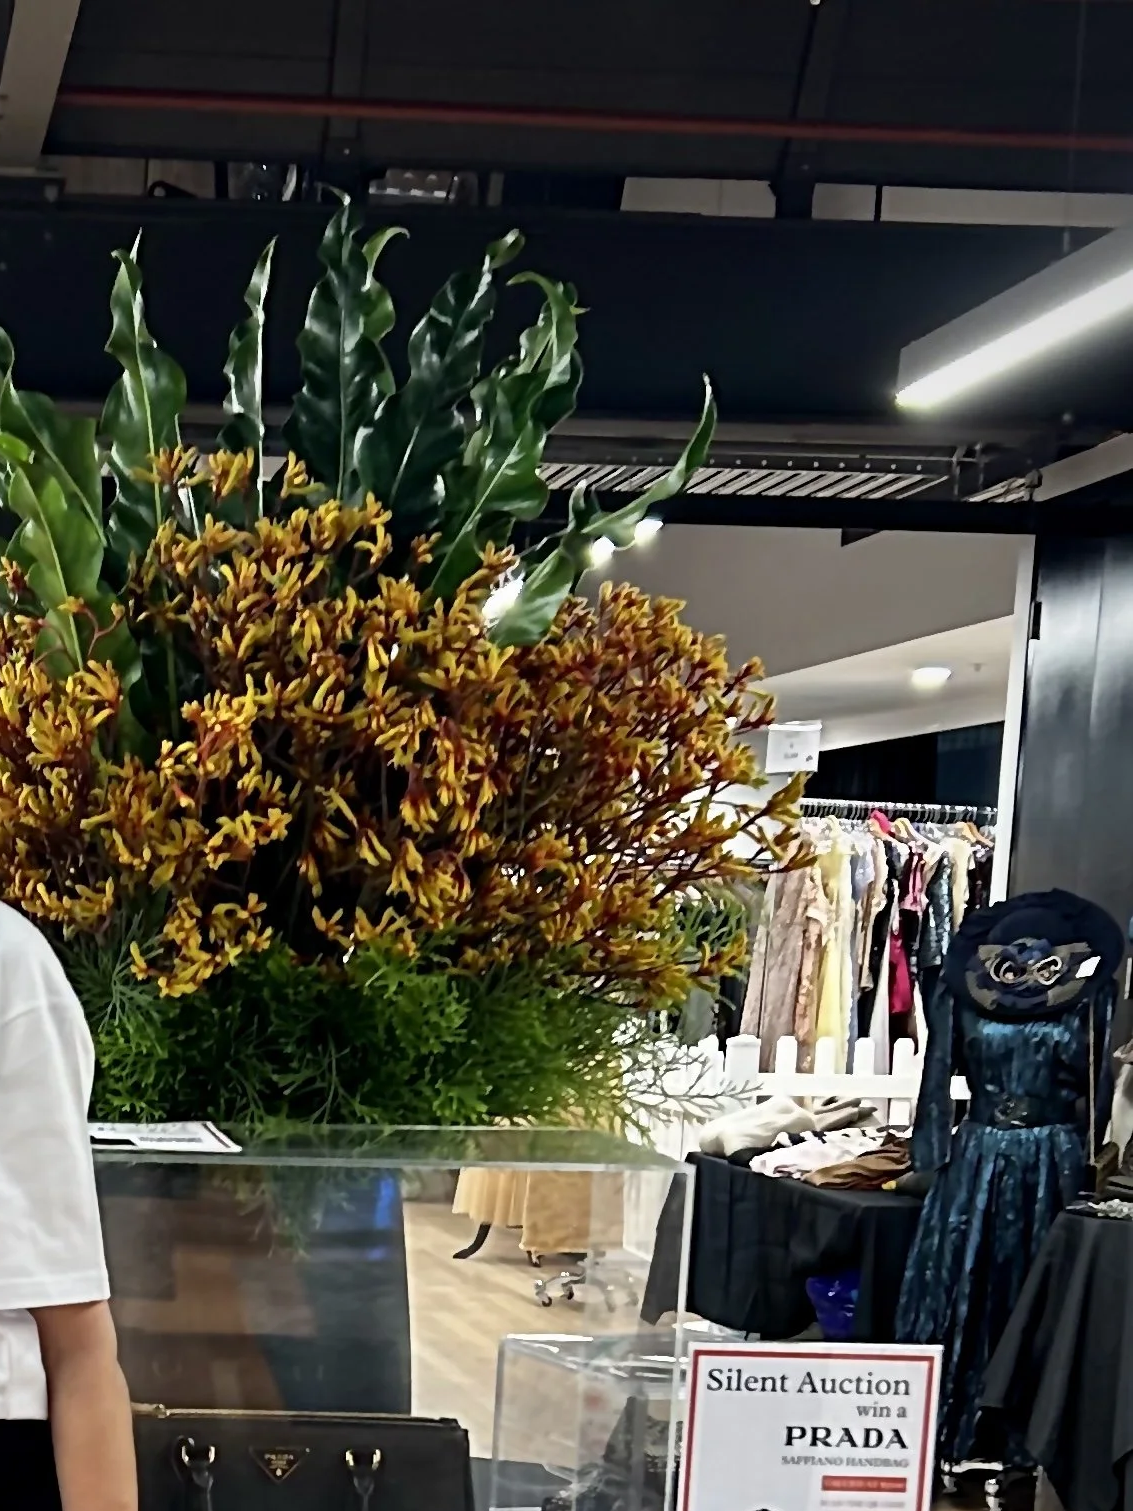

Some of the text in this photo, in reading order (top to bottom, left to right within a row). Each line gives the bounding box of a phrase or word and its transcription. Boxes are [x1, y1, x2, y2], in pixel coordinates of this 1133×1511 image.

[706, 1368, 910, 1396] Silent Auction
[856, 1402, 907, 1418] win a
[785, 1426, 909, 1449] PRADA
[845, 1457, 910, 1468] HANDBAG
